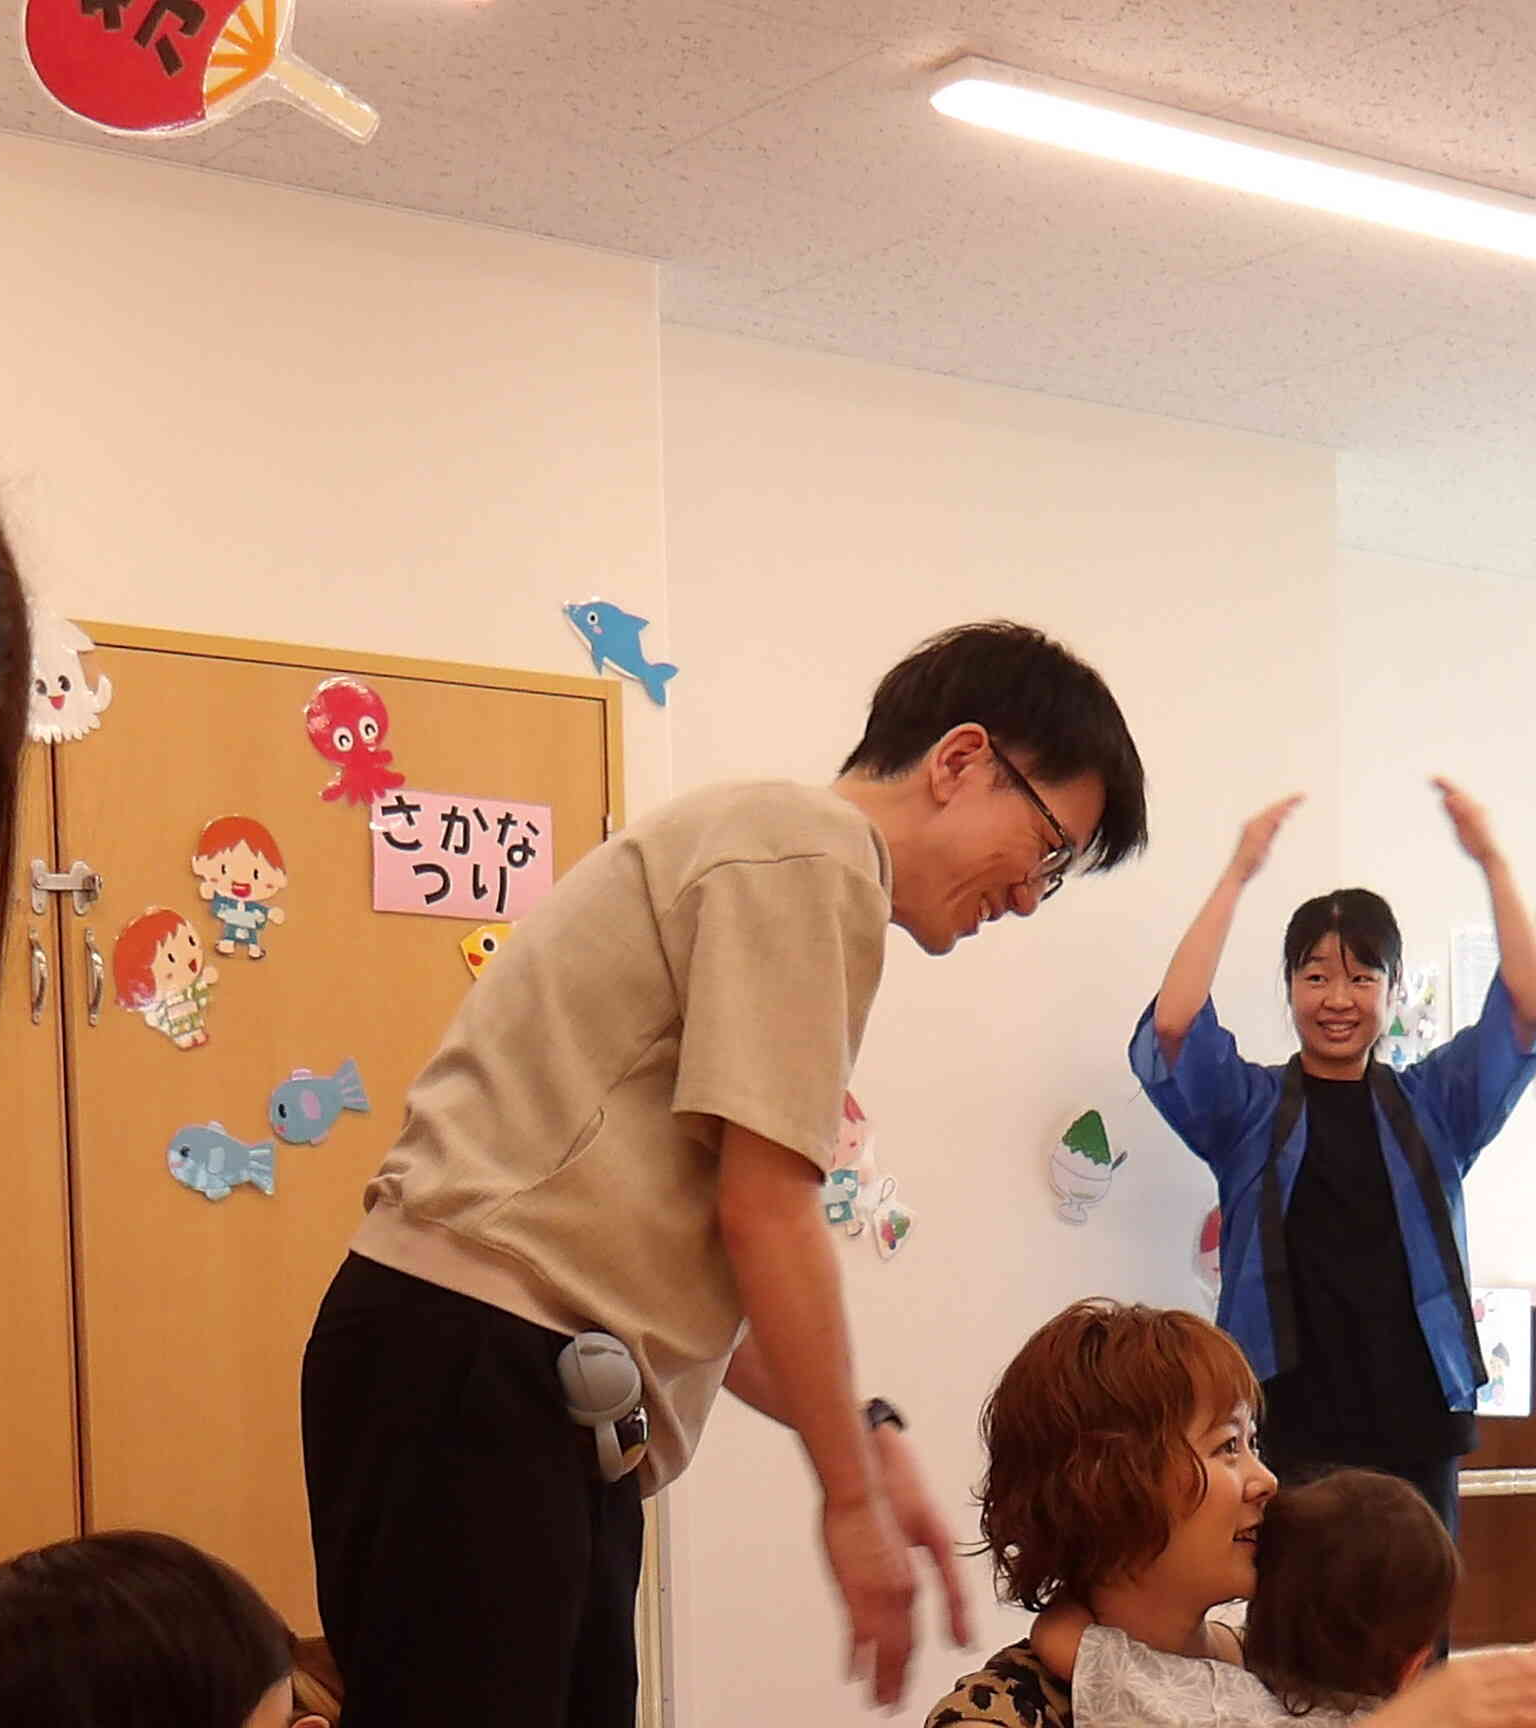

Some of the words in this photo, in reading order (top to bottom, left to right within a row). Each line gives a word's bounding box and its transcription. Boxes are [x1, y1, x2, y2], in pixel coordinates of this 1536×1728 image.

[381, 795, 540, 869] さかな
[412, 863, 508, 914] つり
